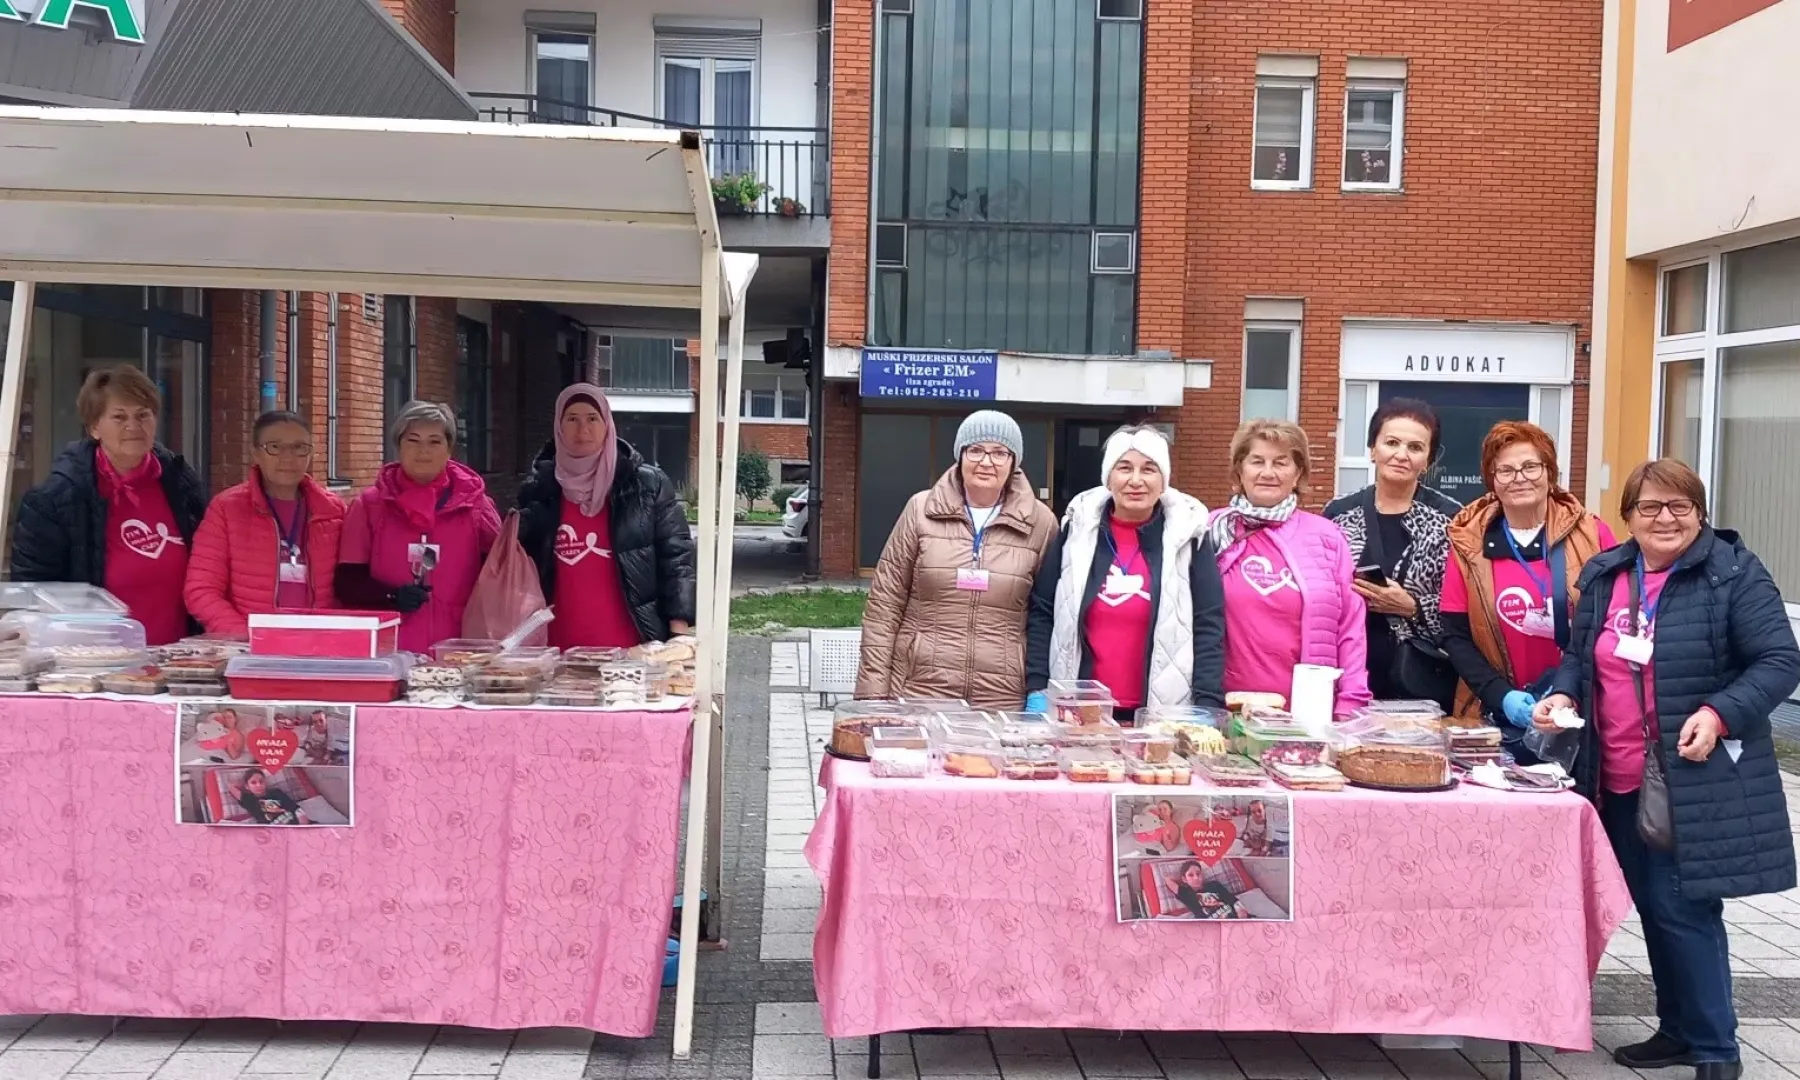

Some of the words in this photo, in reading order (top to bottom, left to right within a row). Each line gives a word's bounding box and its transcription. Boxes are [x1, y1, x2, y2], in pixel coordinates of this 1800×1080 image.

[867, 352, 901, 361] MUŠKI
[902, 353, 957, 362] FRIZERSKI
[959, 355, 993, 364] SALON
[1405, 355, 1506, 373] ADVOKAT
[894, 363, 940, 376] Frizer
[923, 379, 955, 387] zgrade)
[1440, 475, 1463, 484] ALBINA
[1502, 598, 1520, 607] TIM
[265, 758, 280, 766] OD
[1193, 830, 1226, 839] HVALA
[1196, 839, 1221, 848] VAM
[1202, 849, 1217, 857] OD
